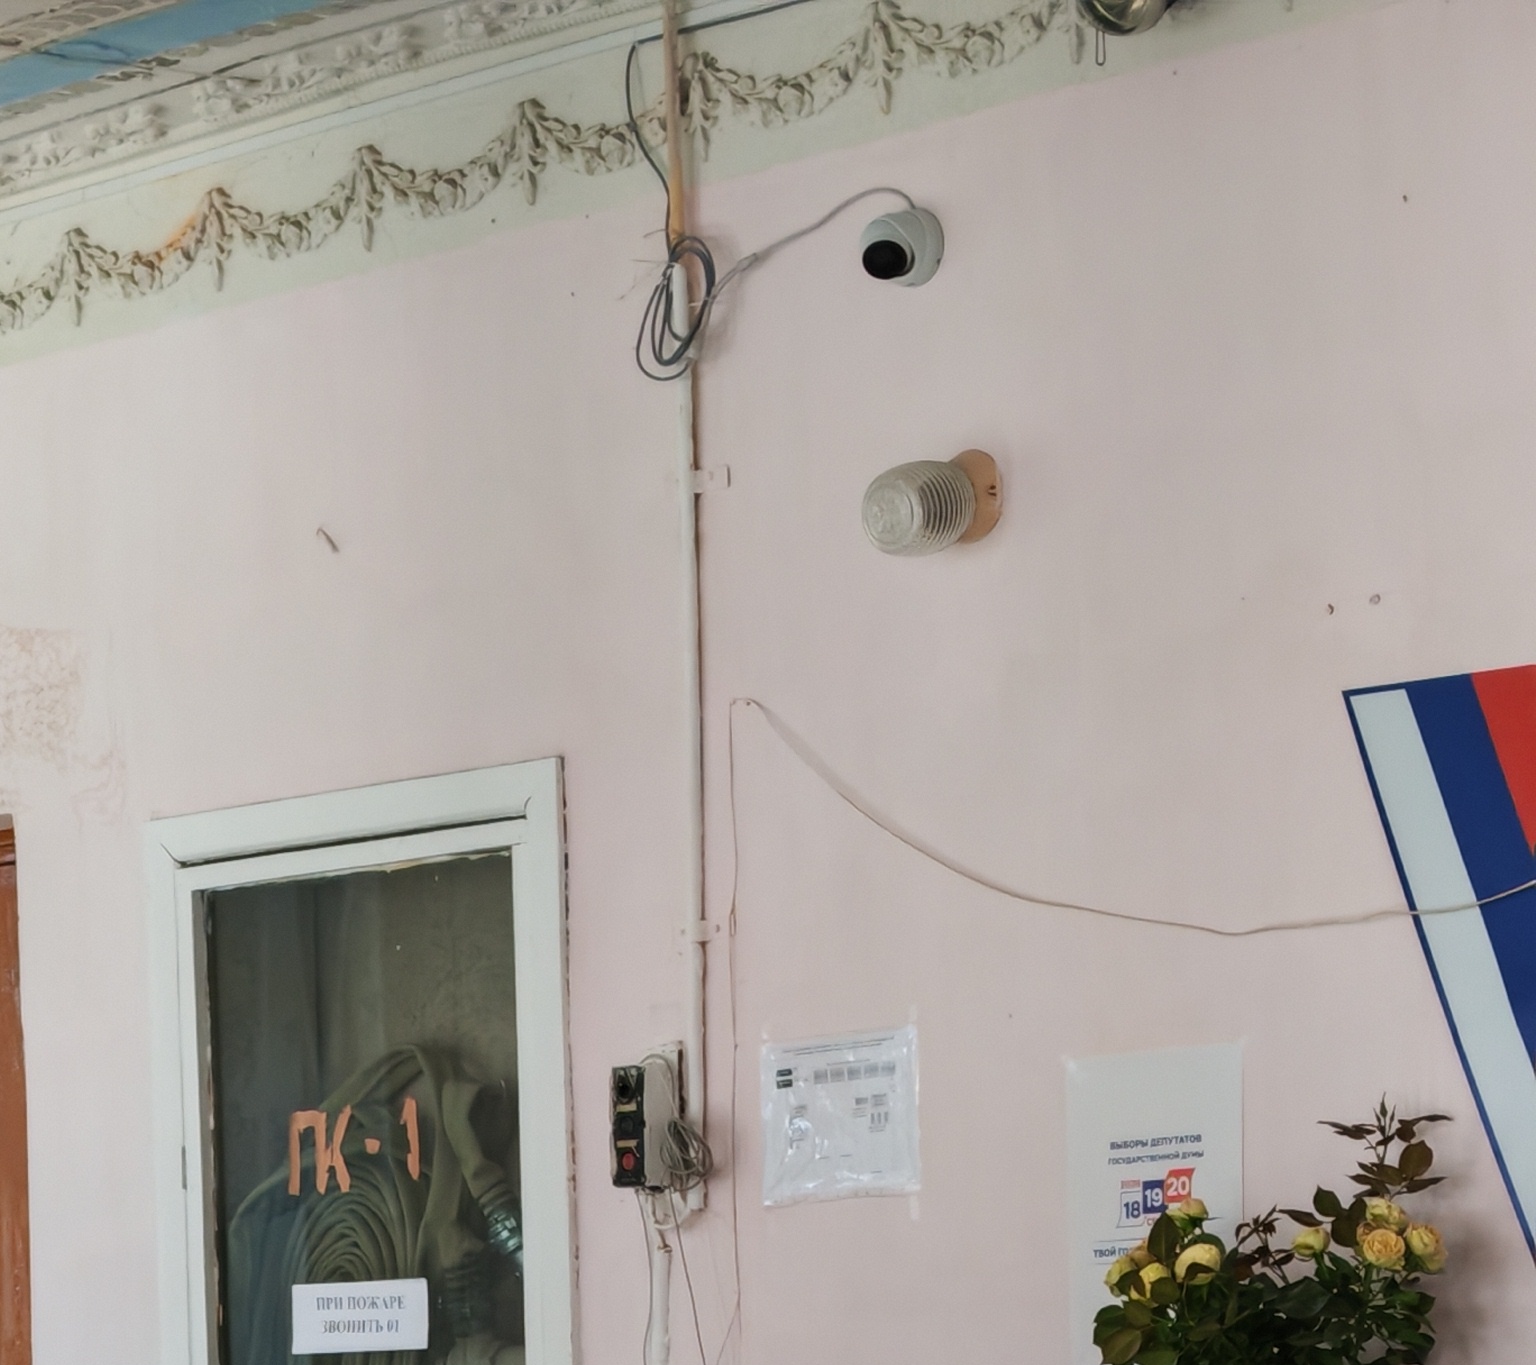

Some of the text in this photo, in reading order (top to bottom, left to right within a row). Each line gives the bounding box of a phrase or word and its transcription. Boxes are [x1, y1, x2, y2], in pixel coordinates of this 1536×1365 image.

[1109, 1134, 1202, 1151] ВЫБОРЫ ДЕПУТАТОВ
[1107, 1150, 1205, 1165] ГОСУДАРСТВЕННОЙ ДУМЫ
[1123, 1200, 1141, 1219] 18
[1144, 1187, 1164, 1208] 19
[1166, 1175, 1190, 1197] 20
[1093, 1246, 1116, 1258] ТВОЙ
[316, 1295, 406, 1311] ПРИ ПОЖАРЕ
[322, 1319, 399, 1334] ЗВОНИТЬ 01
